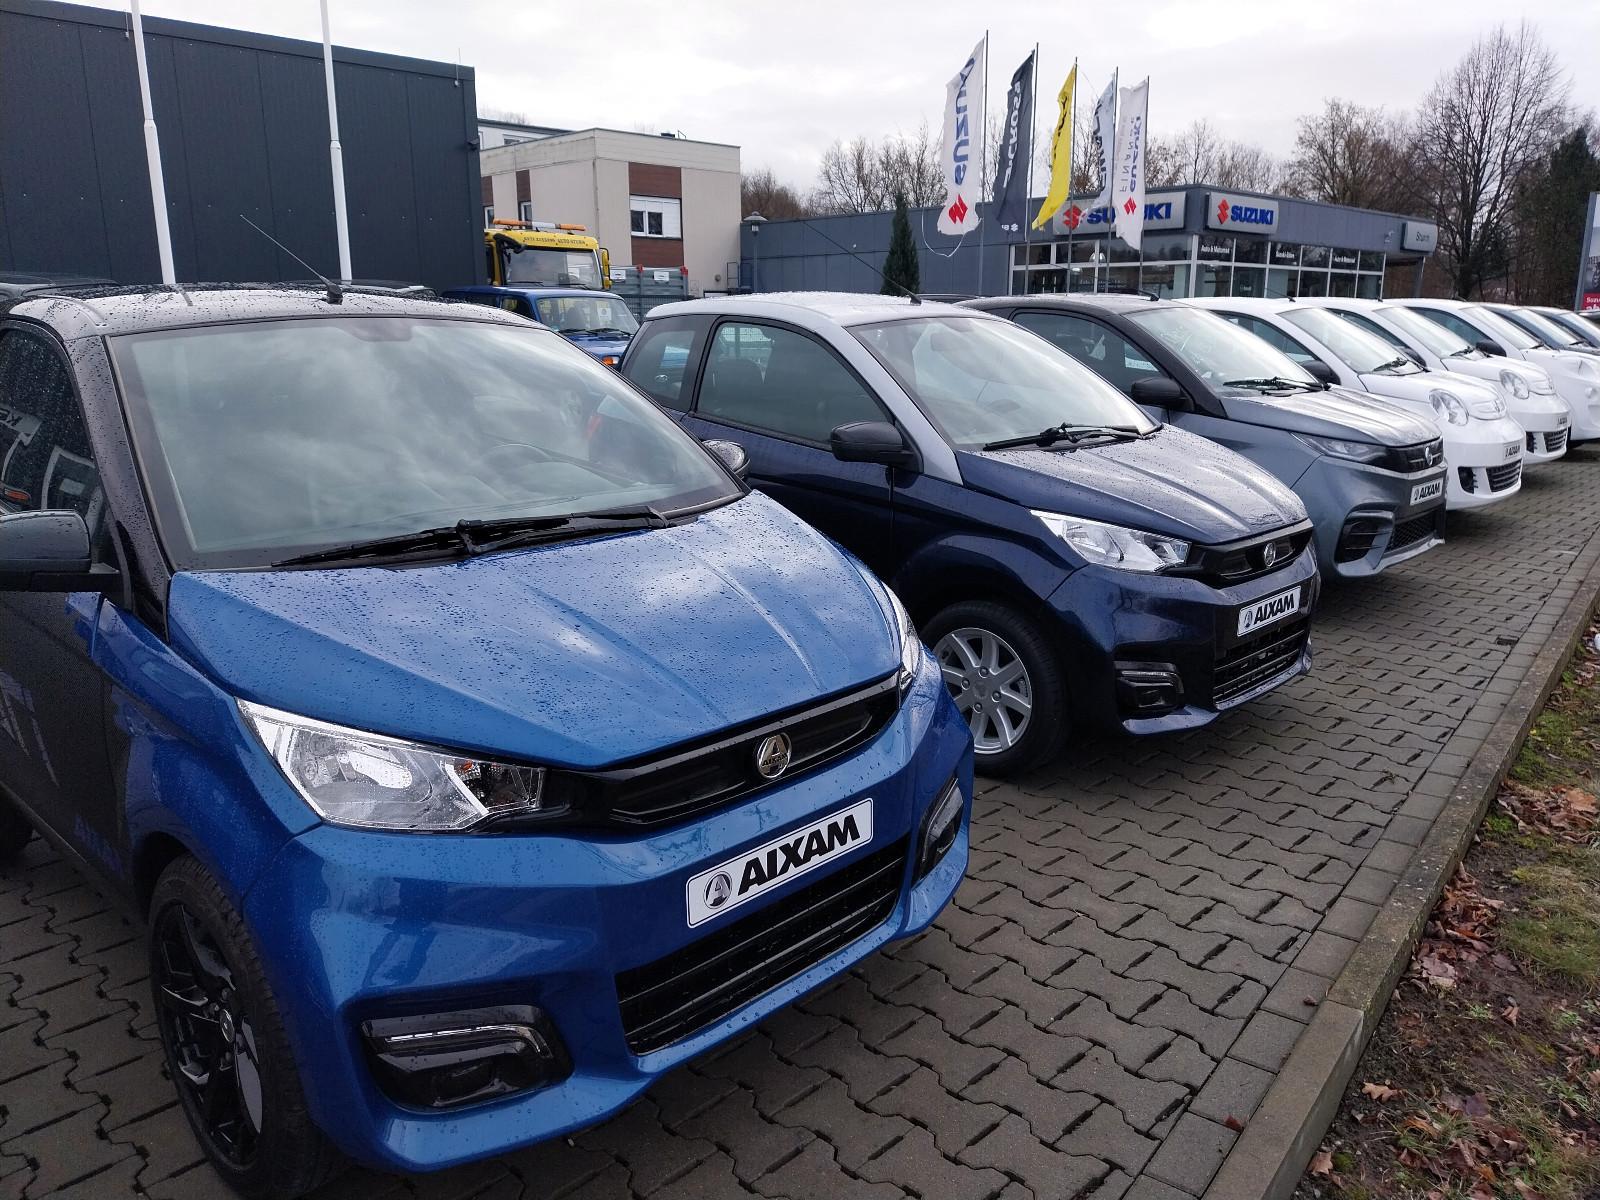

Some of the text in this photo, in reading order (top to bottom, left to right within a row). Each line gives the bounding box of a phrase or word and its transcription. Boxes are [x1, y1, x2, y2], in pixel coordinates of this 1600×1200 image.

[1230, 205, 1274, 226] SUZUKI
[1419, 482, 1441, 499] AIXAM
[1253, 593, 1295, 625] AIXAM
[737, 814, 860, 896] AIXAM
